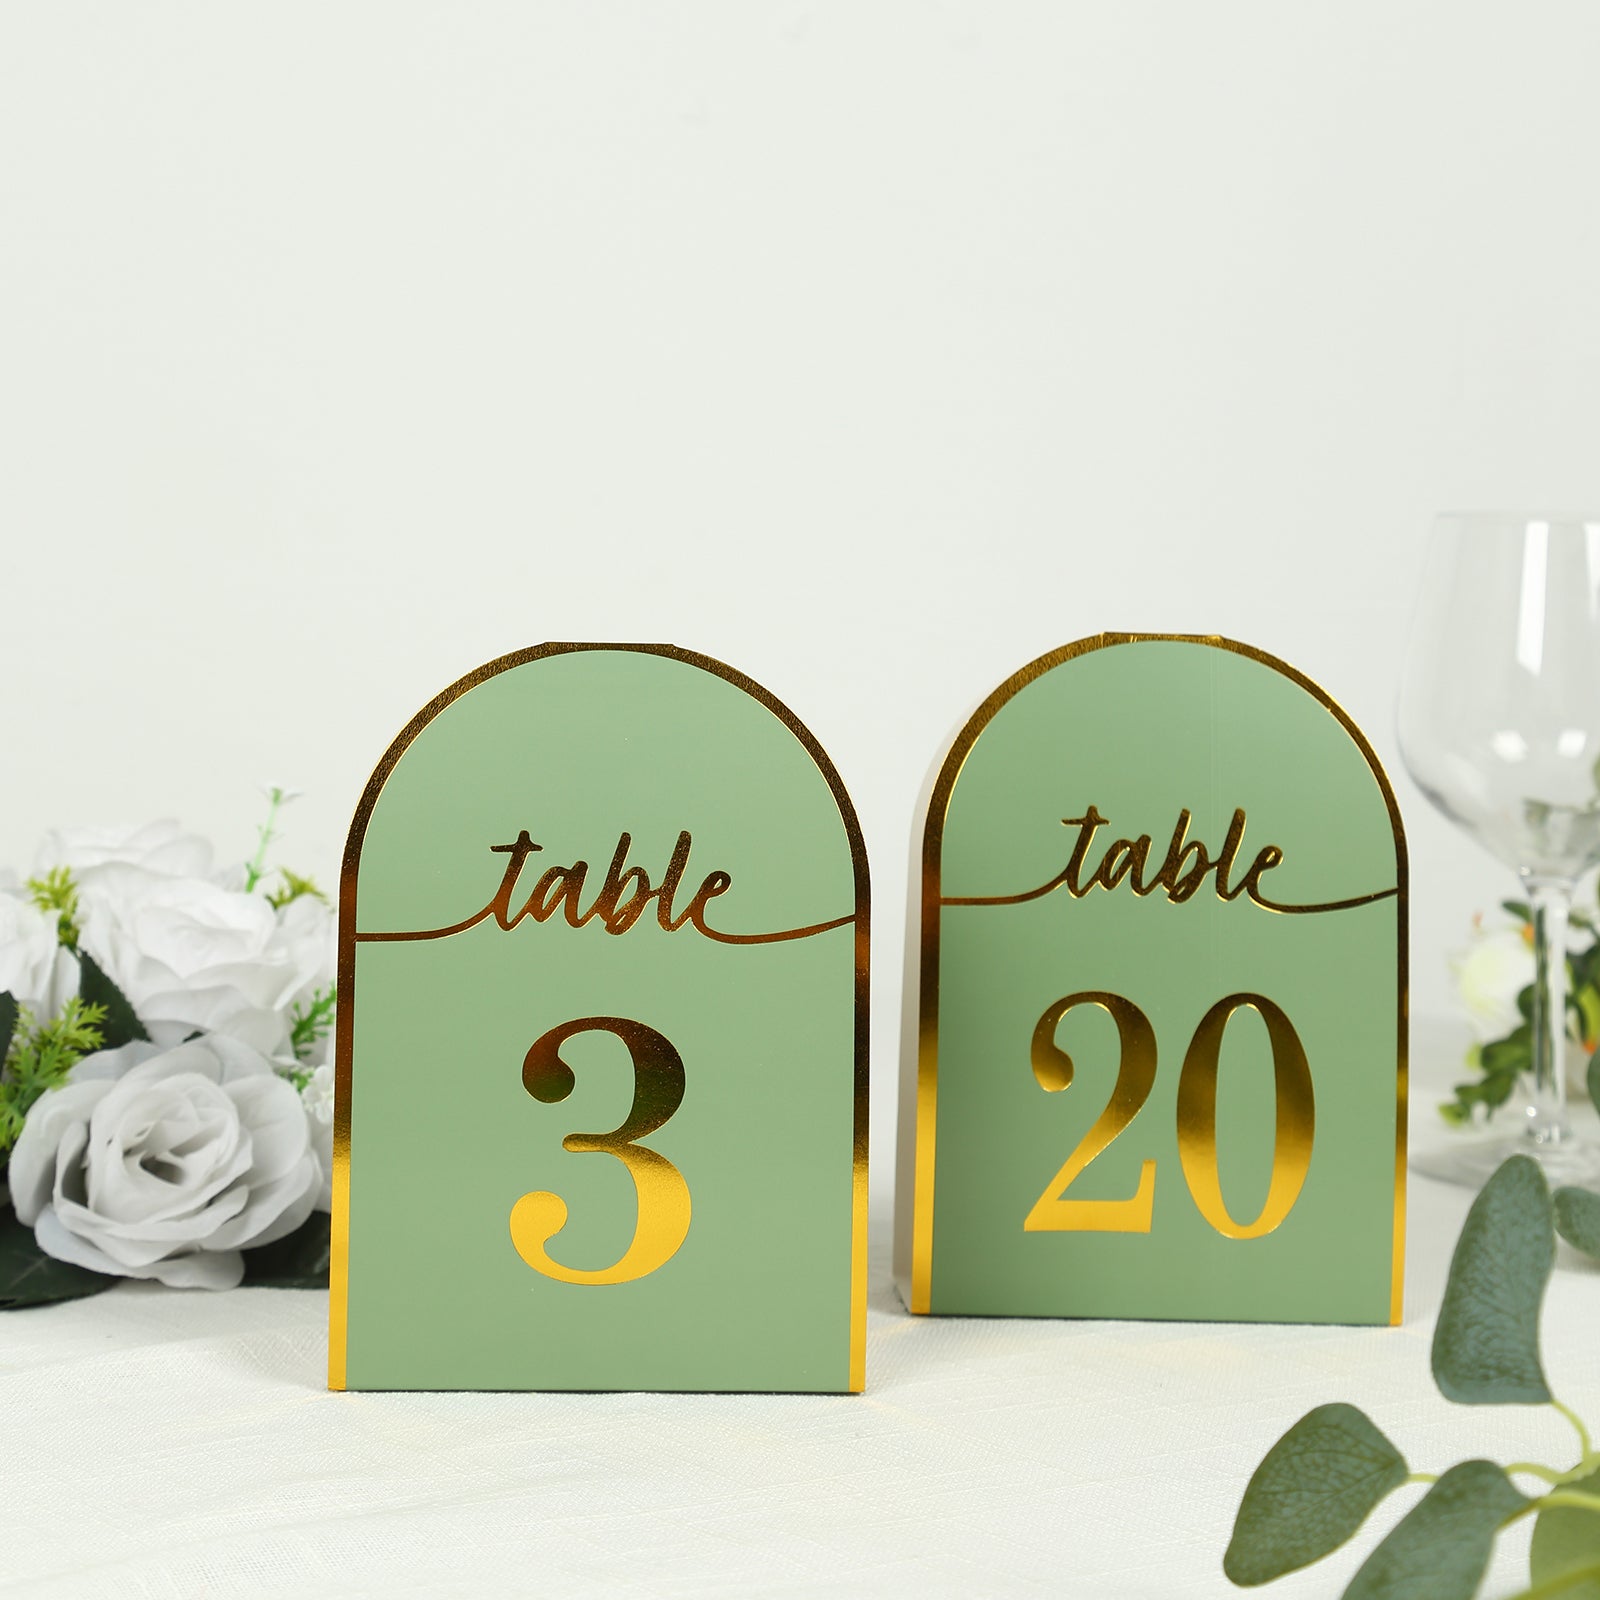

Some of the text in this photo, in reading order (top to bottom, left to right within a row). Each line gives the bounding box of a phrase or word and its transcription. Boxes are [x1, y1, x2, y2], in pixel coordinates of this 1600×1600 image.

[480, 829, 752, 944] table
[1052, 805, 1306, 914] table
[509, 1016, 692, 1286] 3
[1023, 990, 1316, 1240] 20
